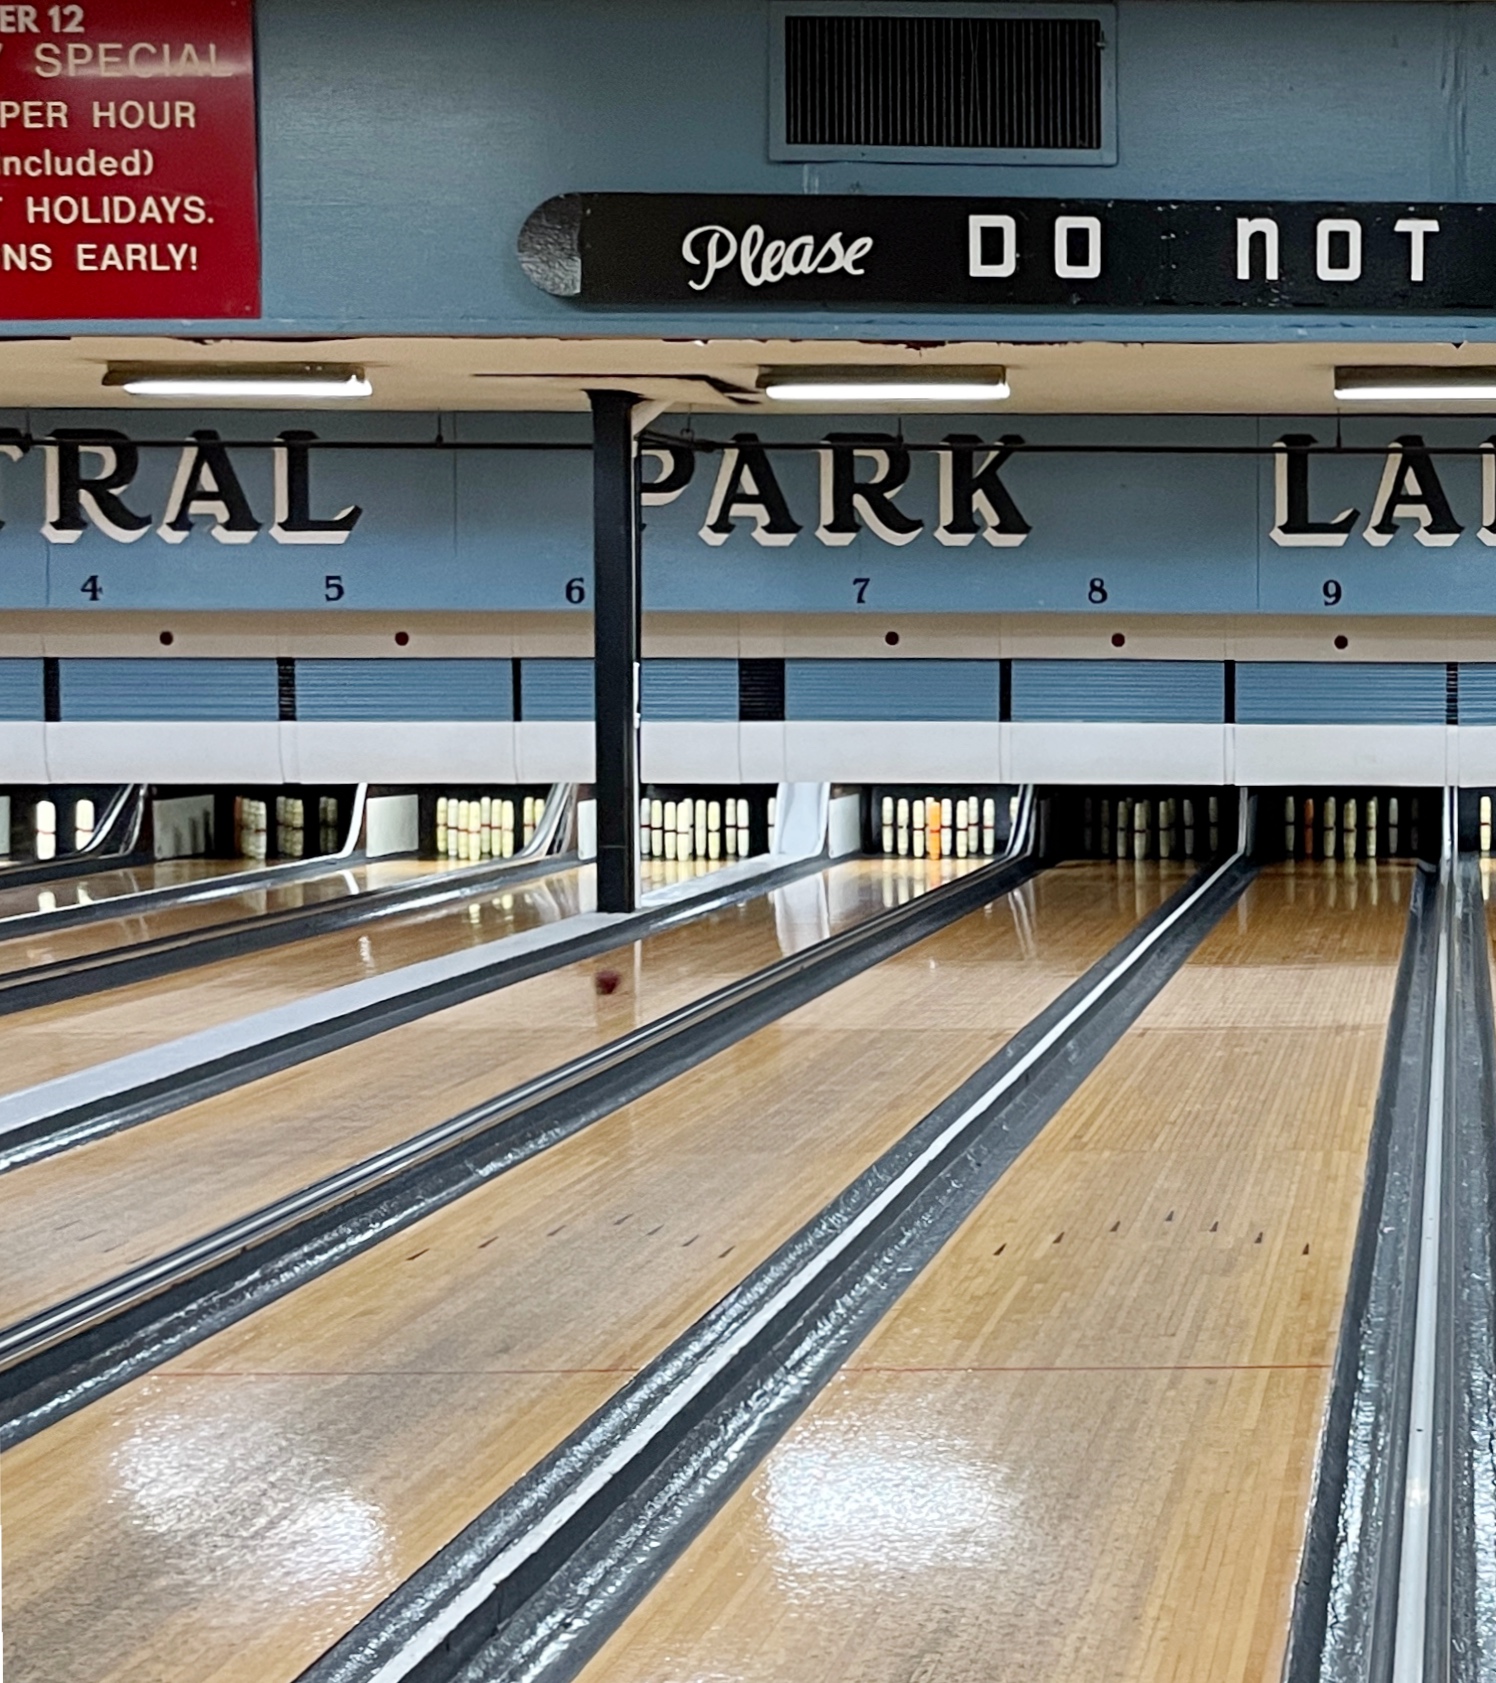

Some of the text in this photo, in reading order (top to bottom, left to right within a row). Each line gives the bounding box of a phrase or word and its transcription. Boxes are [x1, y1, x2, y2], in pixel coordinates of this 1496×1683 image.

[0, 4, 85, 33] ER 12
[34, 42, 234, 79] SPECIAL
[0, 100, 196, 130] PER HOUR
[0, 148, 154, 177] ncluded)
[26, 195, 215, 225] HOLIDAYS.
[2, 243, 198, 272] NS EARLY!
[681, 223, 874, 291] Please
[968, 214, 1102, 279] DO
[1236, 217, 1440, 282] NOT
[640, 432, 1033, 547] PARK
[80, 574, 103, 602] 4
[324, 575, 345, 602] 5
[565, 576, 586, 604] 6
[852, 577, 871, 604] 7
[1088, 577, 1108, 604] 8
[1322, 579, 1342, 606] 9
